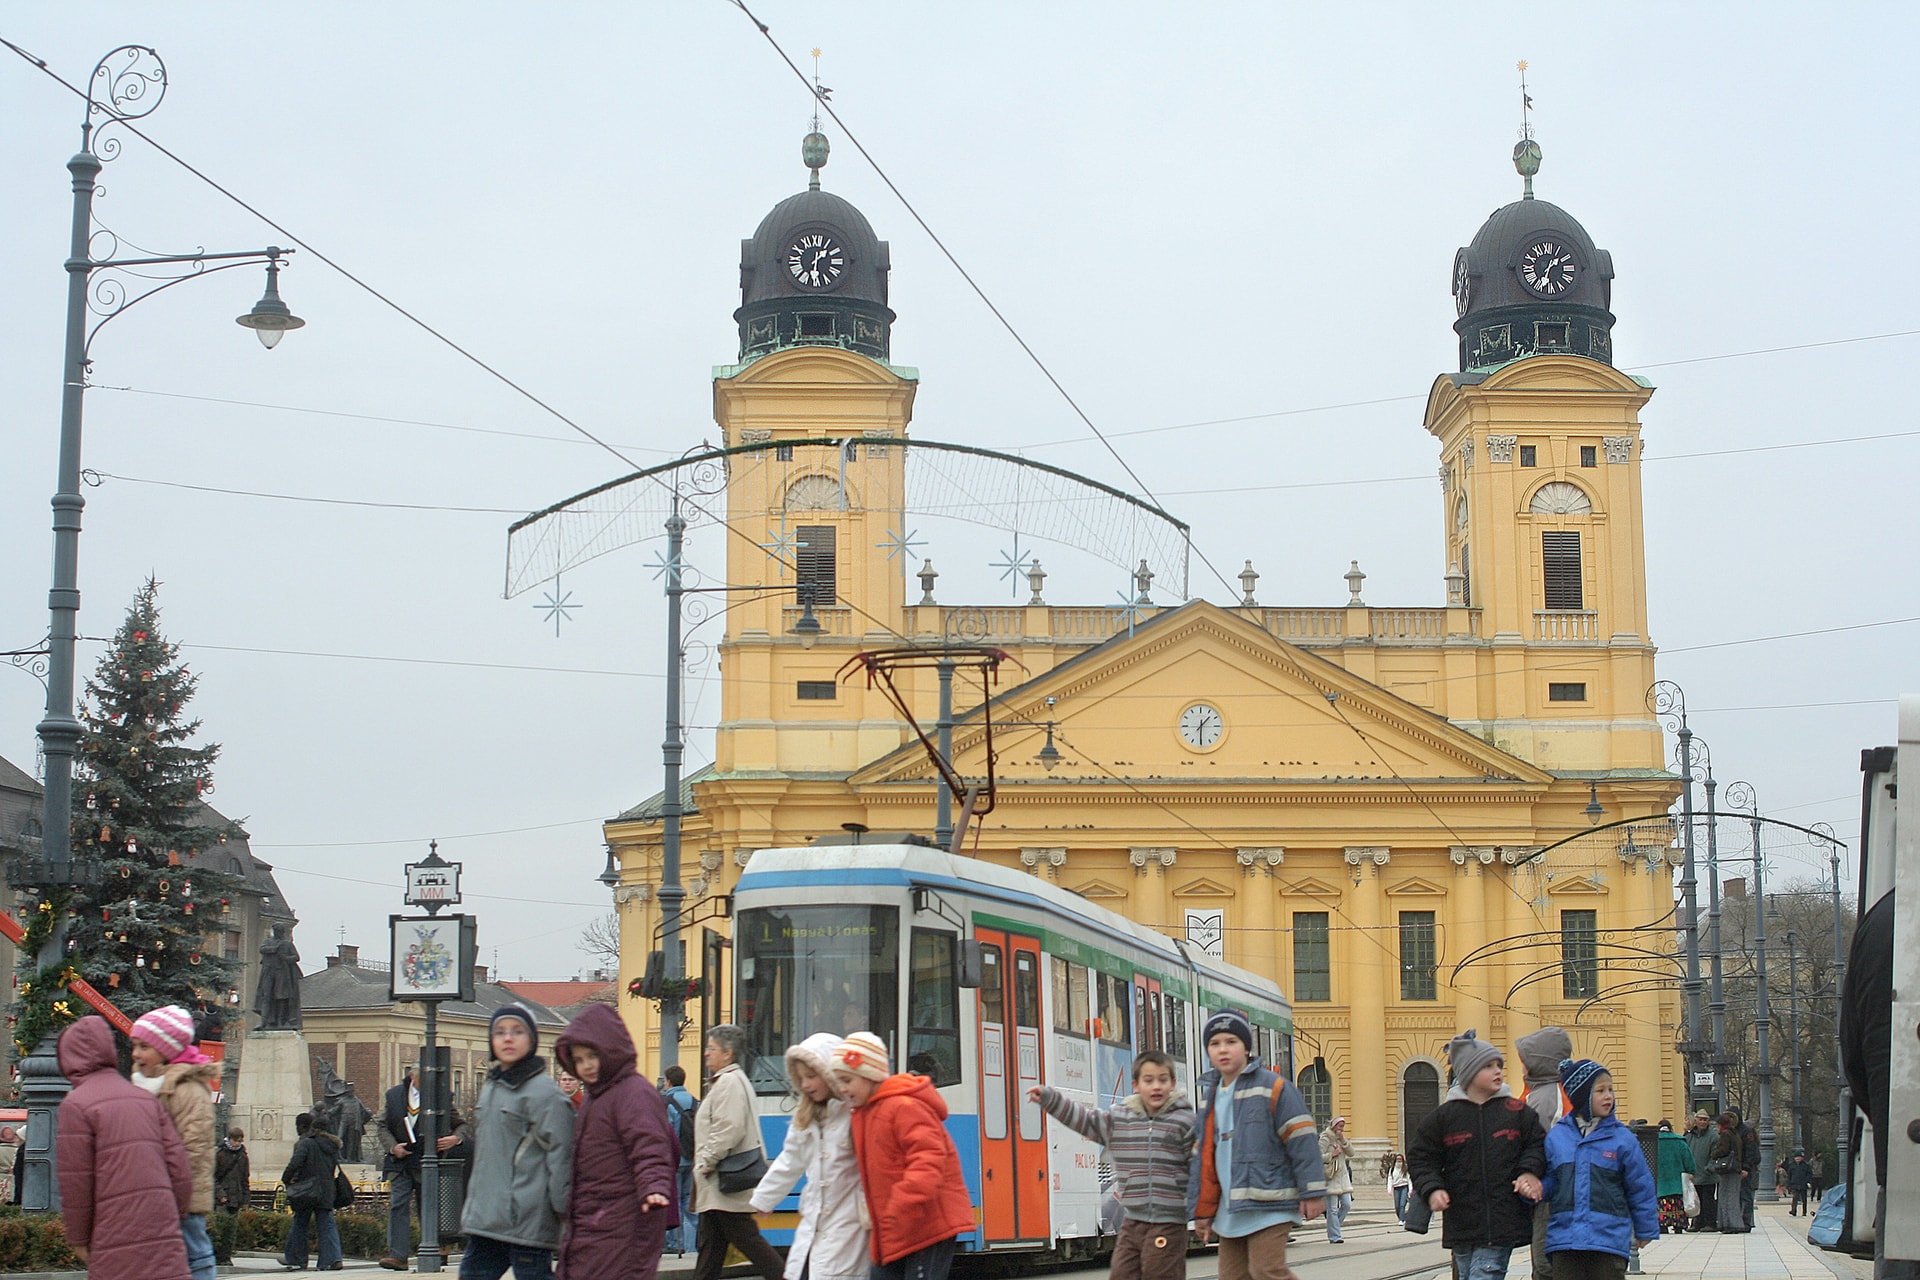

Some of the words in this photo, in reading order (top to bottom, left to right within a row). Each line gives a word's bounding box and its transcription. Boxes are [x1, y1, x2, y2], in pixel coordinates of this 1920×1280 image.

[800, 235, 812, 249] XI
[811, 234, 823, 247] XII
[823, 238, 831, 249] I
[791, 244, 804, 255] X
[1531, 244, 1544, 258] XI
[1542, 242, 1553, 255] XII
[1554, 245, 1561, 256] I
[788, 255, 801, 264] IX
[1524, 253, 1537, 264] X
[1559, 253, 1571, 263] II
[1522, 264, 1535, 273] IX
[822, 273, 832, 285] V
[1556, 280, 1565, 292] V
[420, 887, 444, 899] MM
[760, 921, 773, 943] 1
